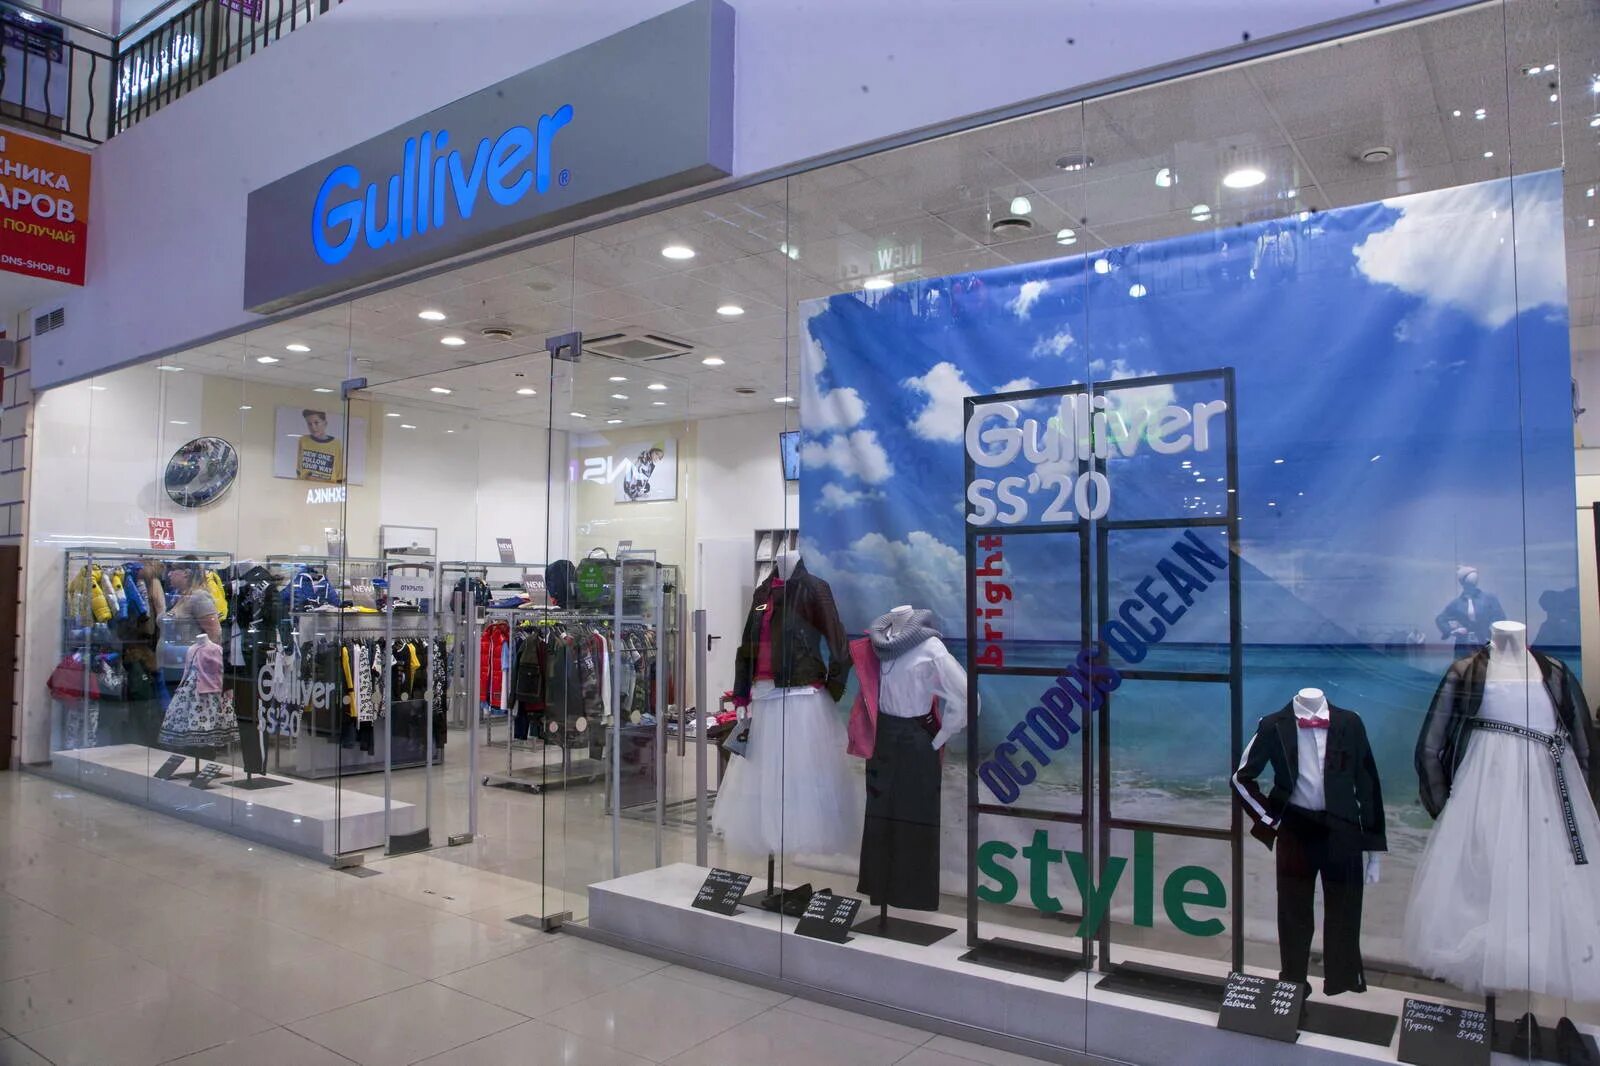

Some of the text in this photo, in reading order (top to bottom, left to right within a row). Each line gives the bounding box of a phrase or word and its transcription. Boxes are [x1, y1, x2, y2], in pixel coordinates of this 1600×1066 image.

[312, 103, 574, 266] Gulliver
[4, 217, 76, 244] ПОЛУЧАЙ
[1, 254, 71, 276] DNS-SHOP.RU
[965, 393, 1227, 468] Gulliver
[304, 457, 327, 465] FOLLOW
[499, 542, 512, 550] NEW
[352, 585, 372, 593] NEW
[526, 581, 545, 589] NEW
[976, 534, 1013, 668] bright
[978, 528, 1229, 805] OCTOPUS OCEAN
[976, 830, 1227, 938] style
[1404, 1018, 1434, 1032] Туфли
